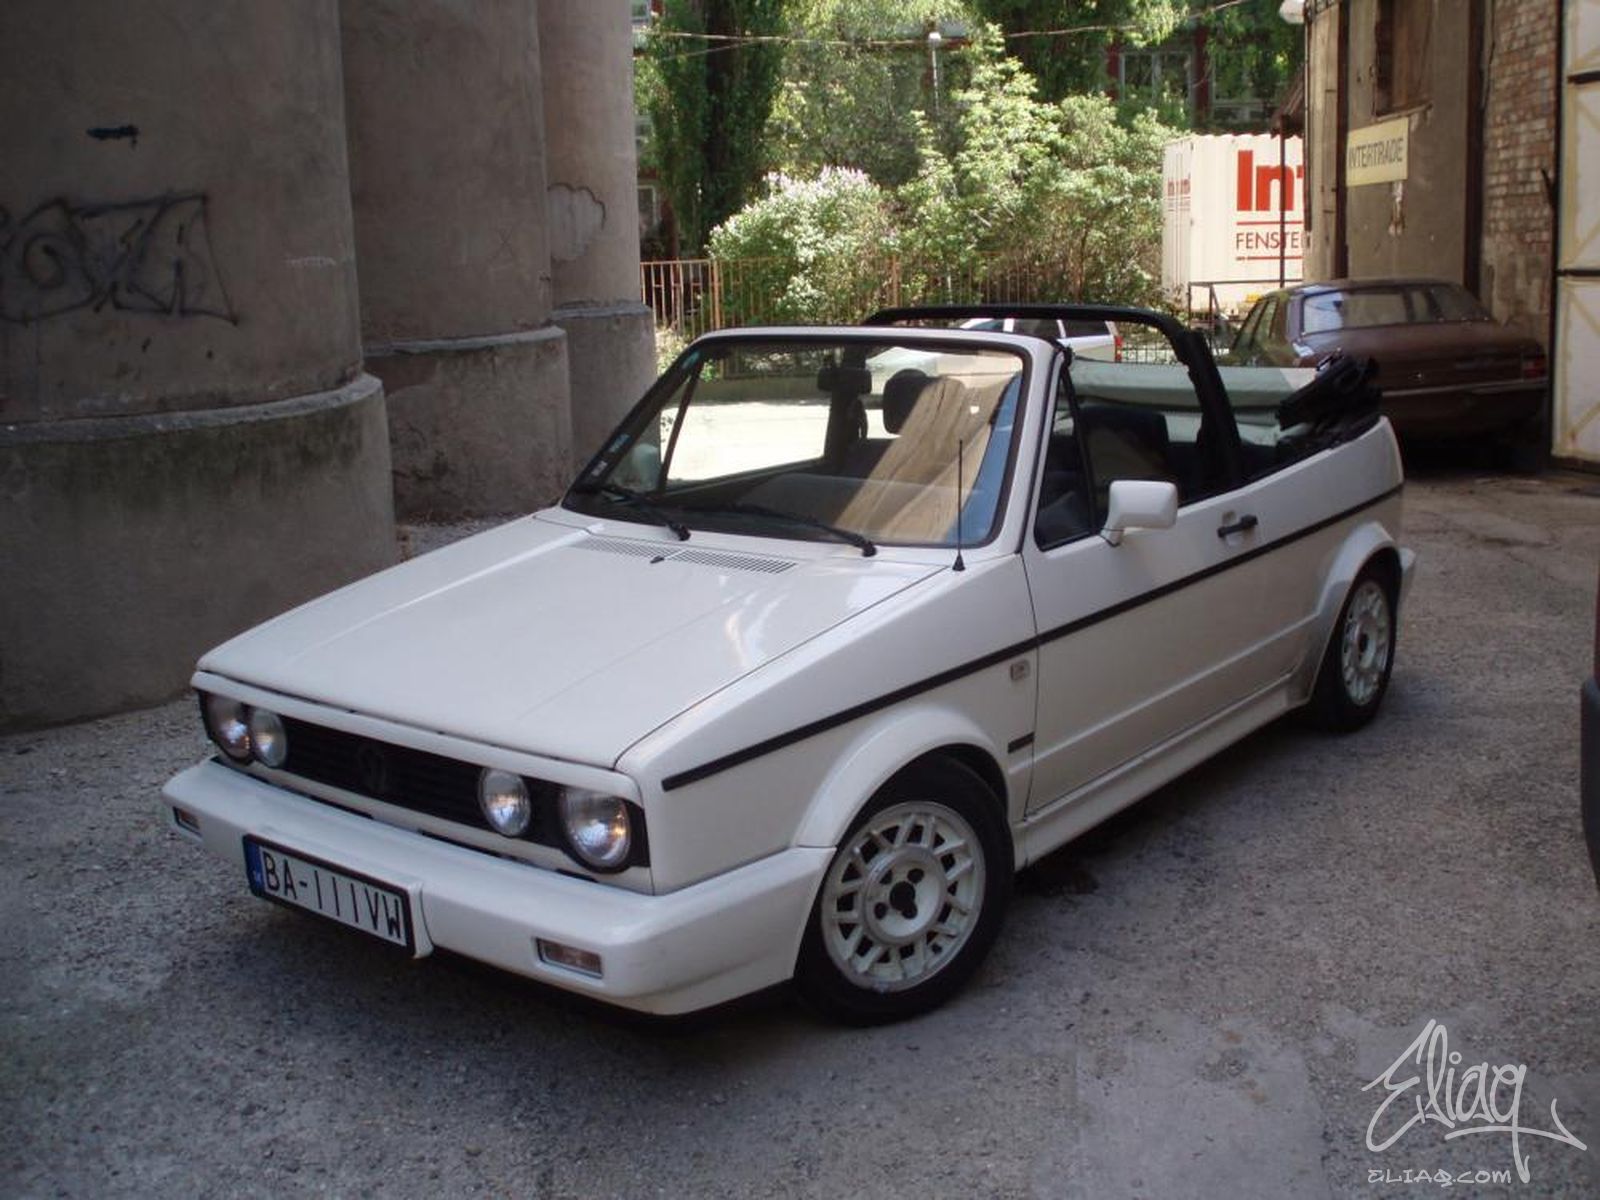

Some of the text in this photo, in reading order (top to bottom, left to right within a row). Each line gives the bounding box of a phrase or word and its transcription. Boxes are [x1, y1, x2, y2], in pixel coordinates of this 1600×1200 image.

[1349, 137, 1404, 169] NTERTRADE
[1237, 150, 1305, 211] In
[1236, 232, 1303, 249] FENSTE
